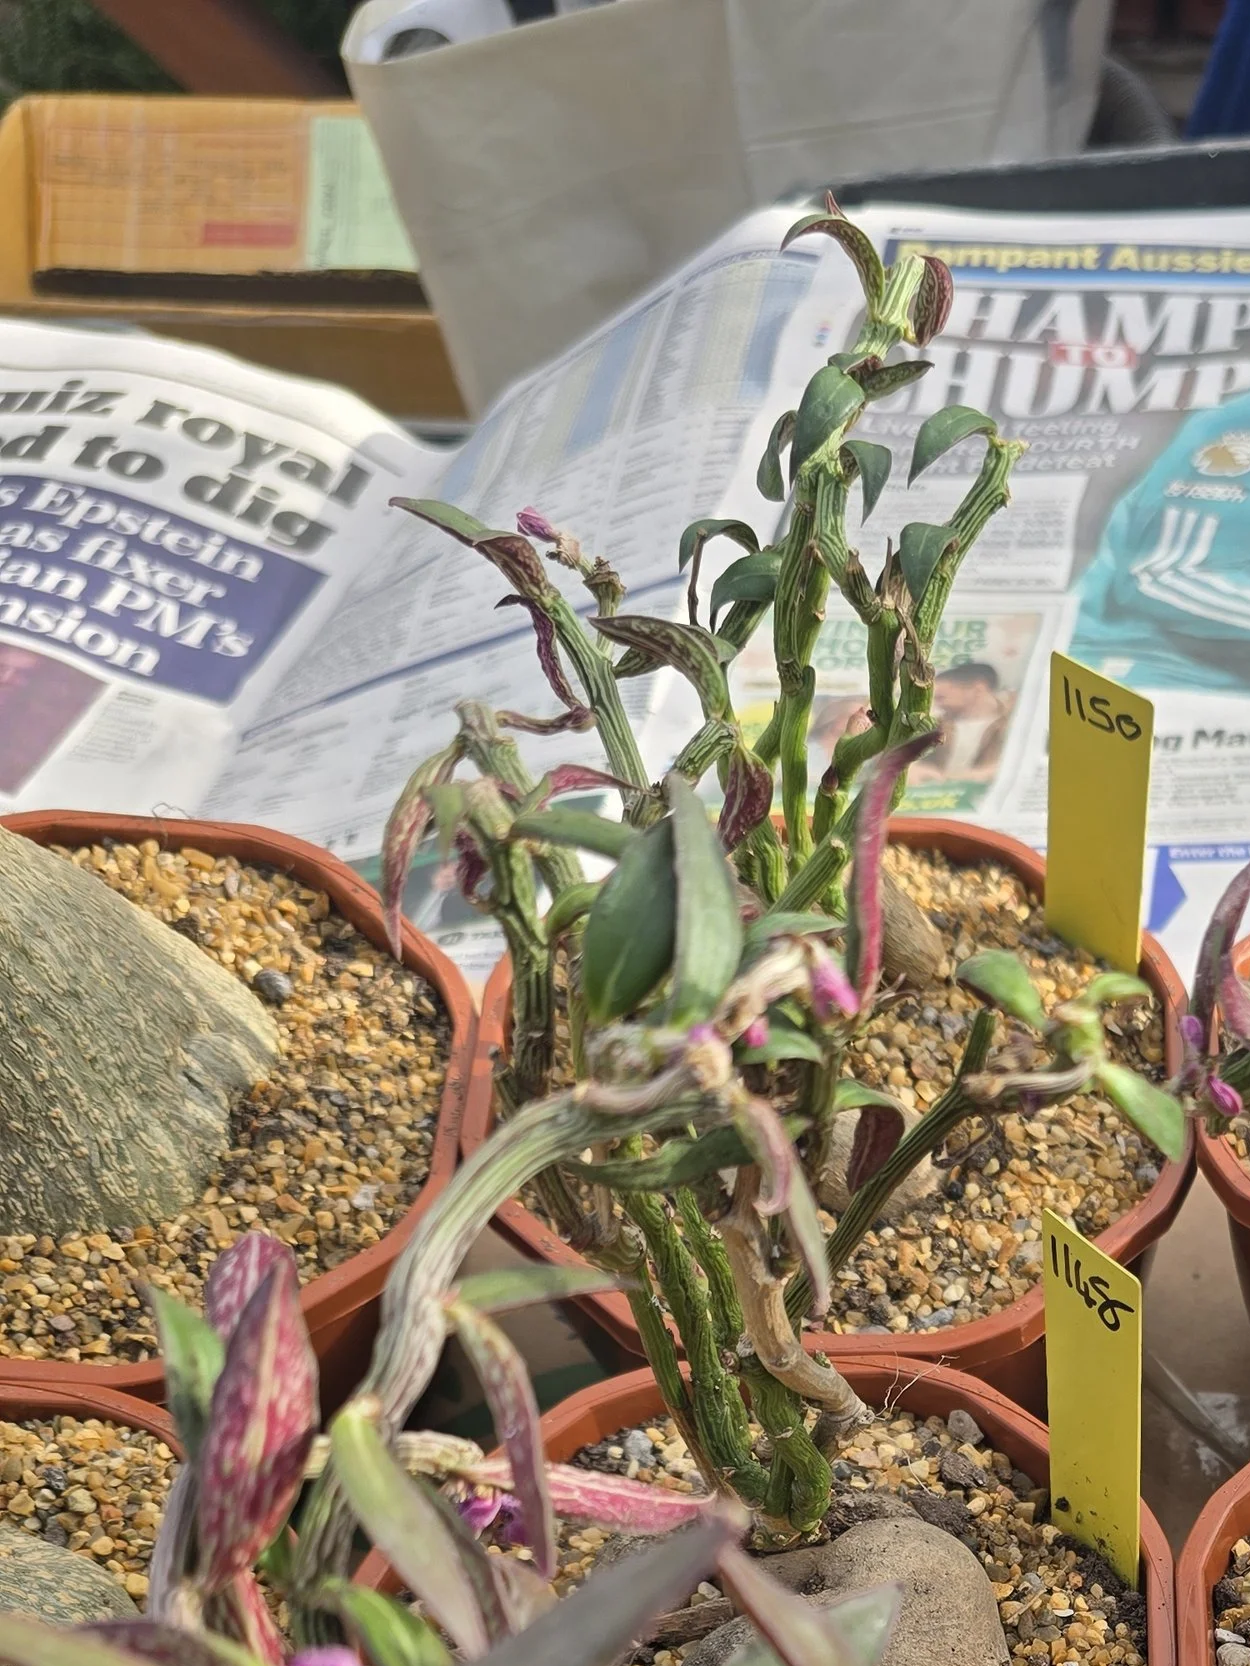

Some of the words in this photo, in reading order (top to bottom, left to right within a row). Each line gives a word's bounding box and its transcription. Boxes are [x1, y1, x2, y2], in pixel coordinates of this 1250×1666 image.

[1064, 343, 1128, 367] TO
[135, 400, 374, 509] royal
[1014, 419, 1119, 437] feeling
[1026, 435, 1141, 453] OURTH
[0, 425, 70, 463] d
[72, 435, 165, 483] to
[182, 471, 336, 555] dig
[22, 481, 265, 583] Epstein
[67, 531, 227, 608] fixer
[89, 575, 255, 658] PM's
[1063, 675, 1142, 741] 1150
[1050, 1234, 1135, 1332] 1148
